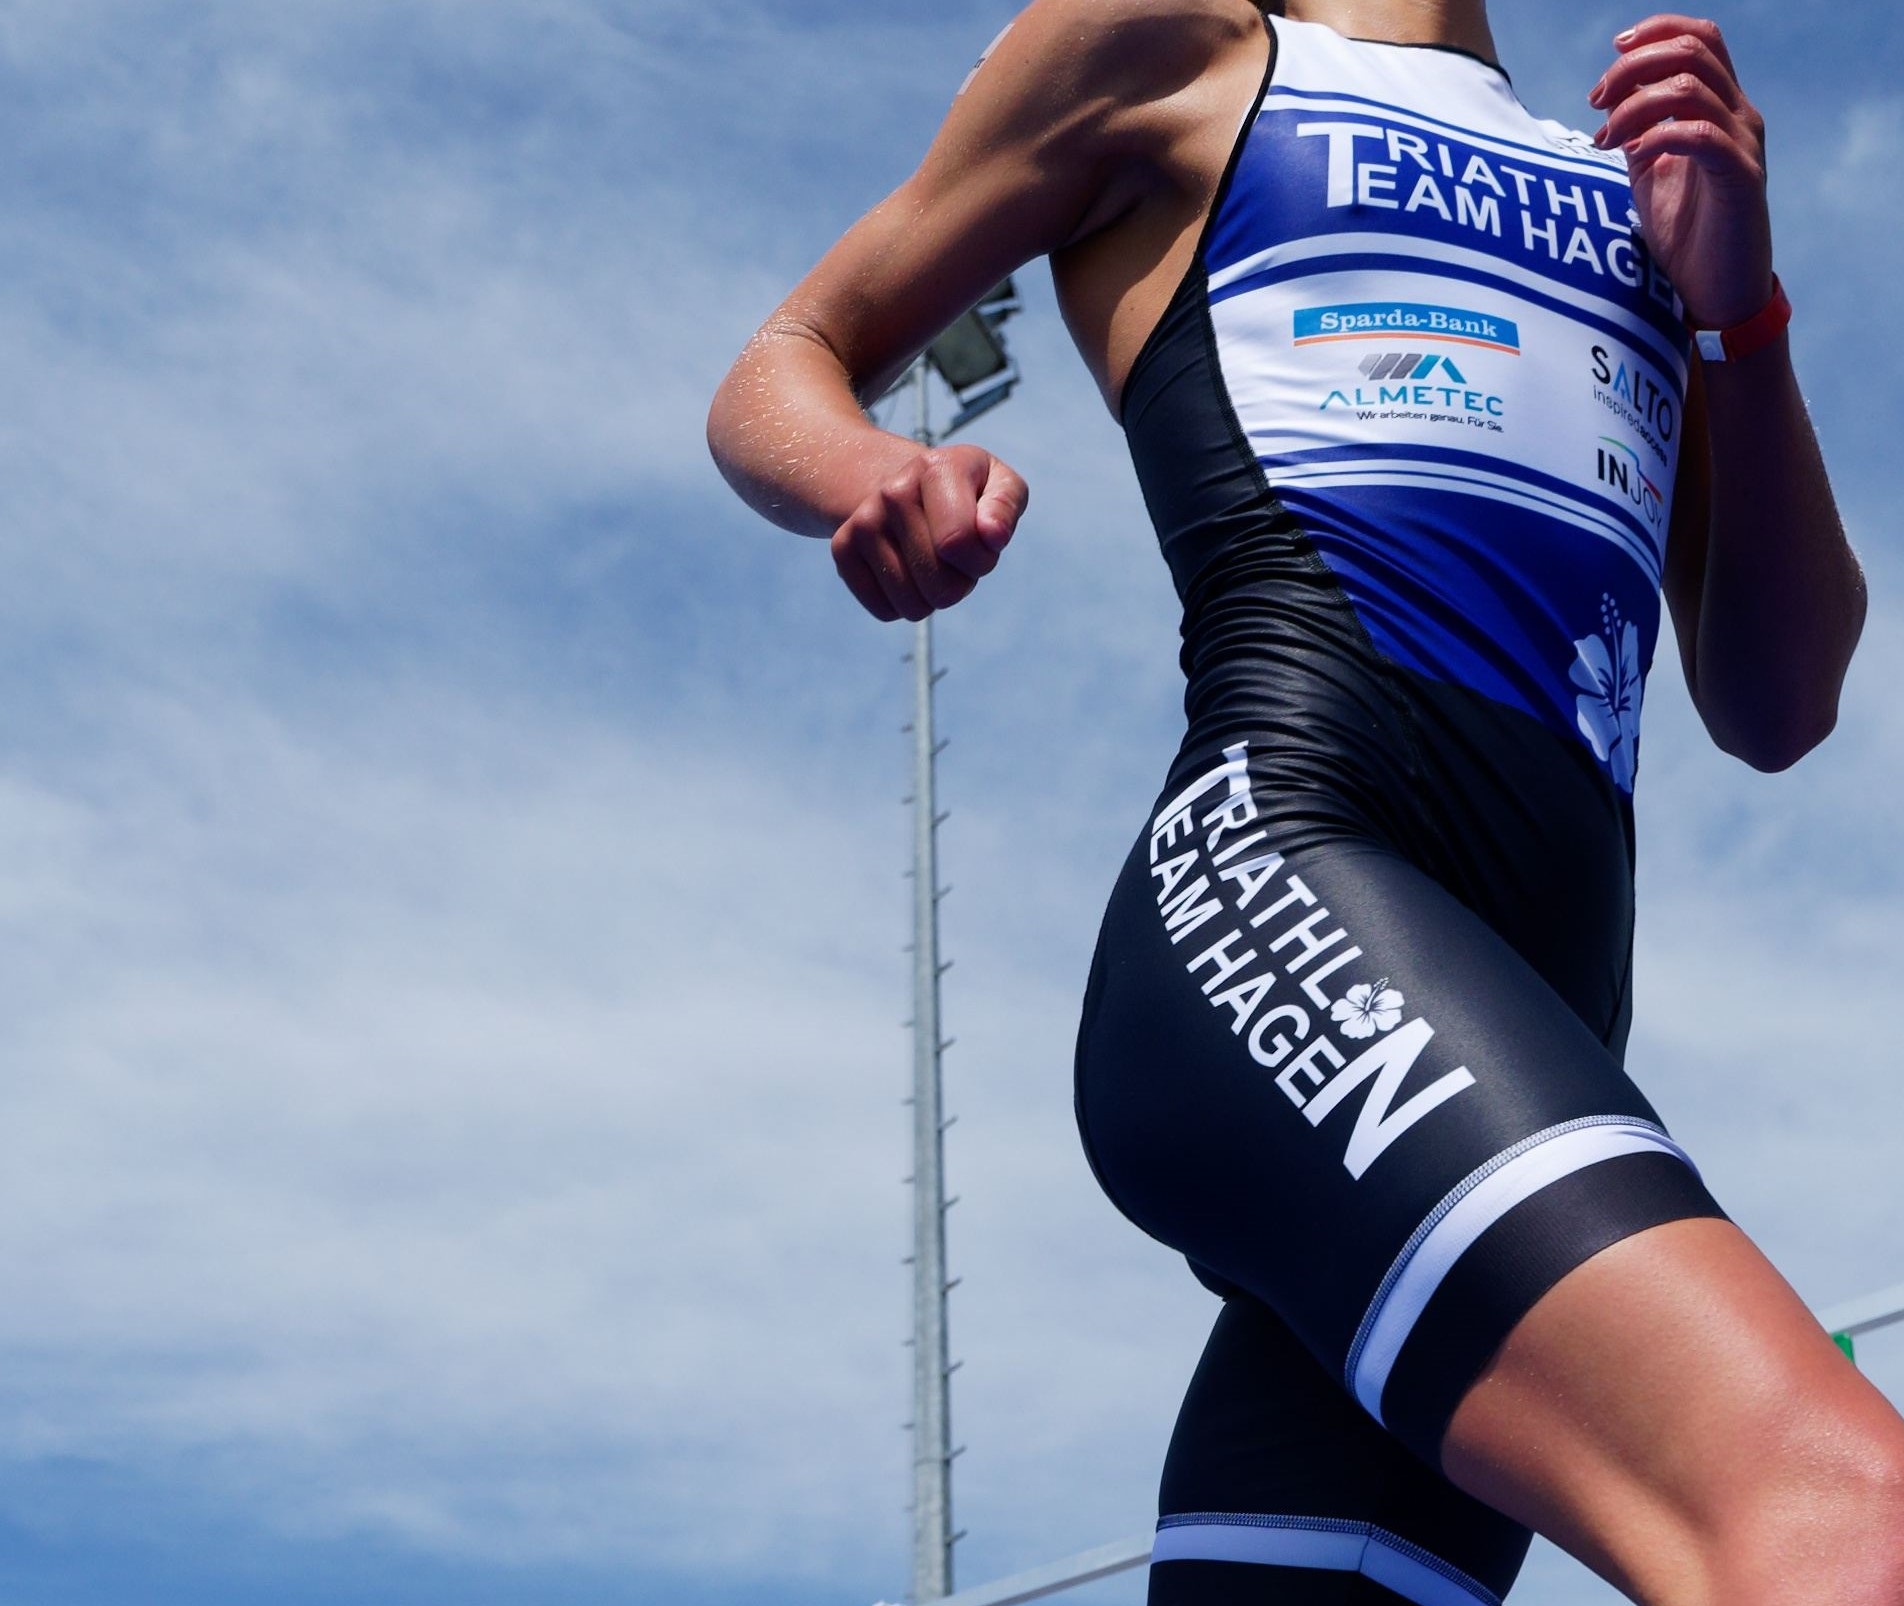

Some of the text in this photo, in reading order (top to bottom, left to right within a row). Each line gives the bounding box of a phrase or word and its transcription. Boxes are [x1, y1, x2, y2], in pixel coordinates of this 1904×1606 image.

[1298, 122, 1641, 236] TRIATHL
[1319, 309, 1497, 337] Sparda-Bank
[1319, 385, 1504, 417] ALMETEC
[1591, 345, 1673, 442] SALTO
